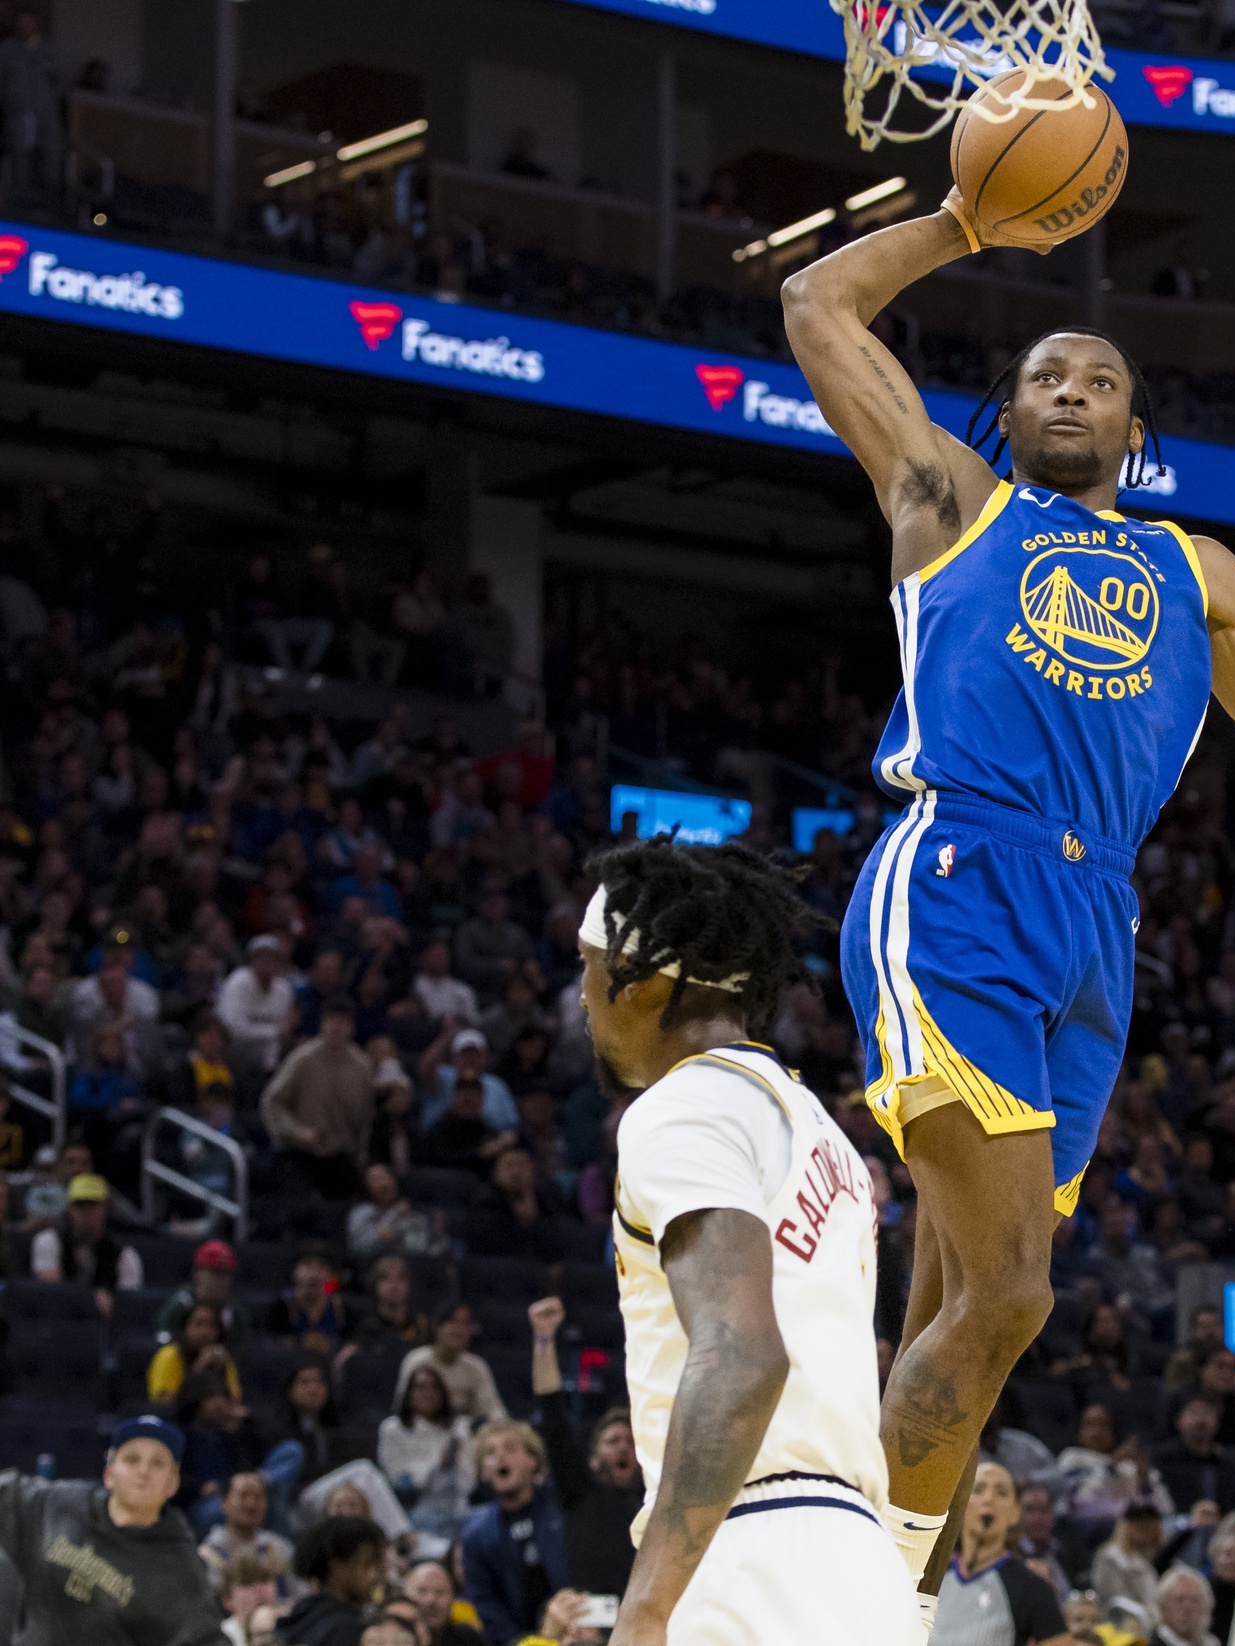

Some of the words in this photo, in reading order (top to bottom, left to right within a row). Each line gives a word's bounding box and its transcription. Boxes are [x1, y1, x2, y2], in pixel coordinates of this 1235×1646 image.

[1032, 144, 1125, 233] Wilson
[28, 251, 184, 319] Fanatics
[402, 317, 545, 383] Fanatics
[743, 379, 838, 437] Fana
[1022, 530, 1107, 552] GOLDEN
[1099, 576, 1150, 620] 00
[1005, 622, 1153, 700] WARRIORS
